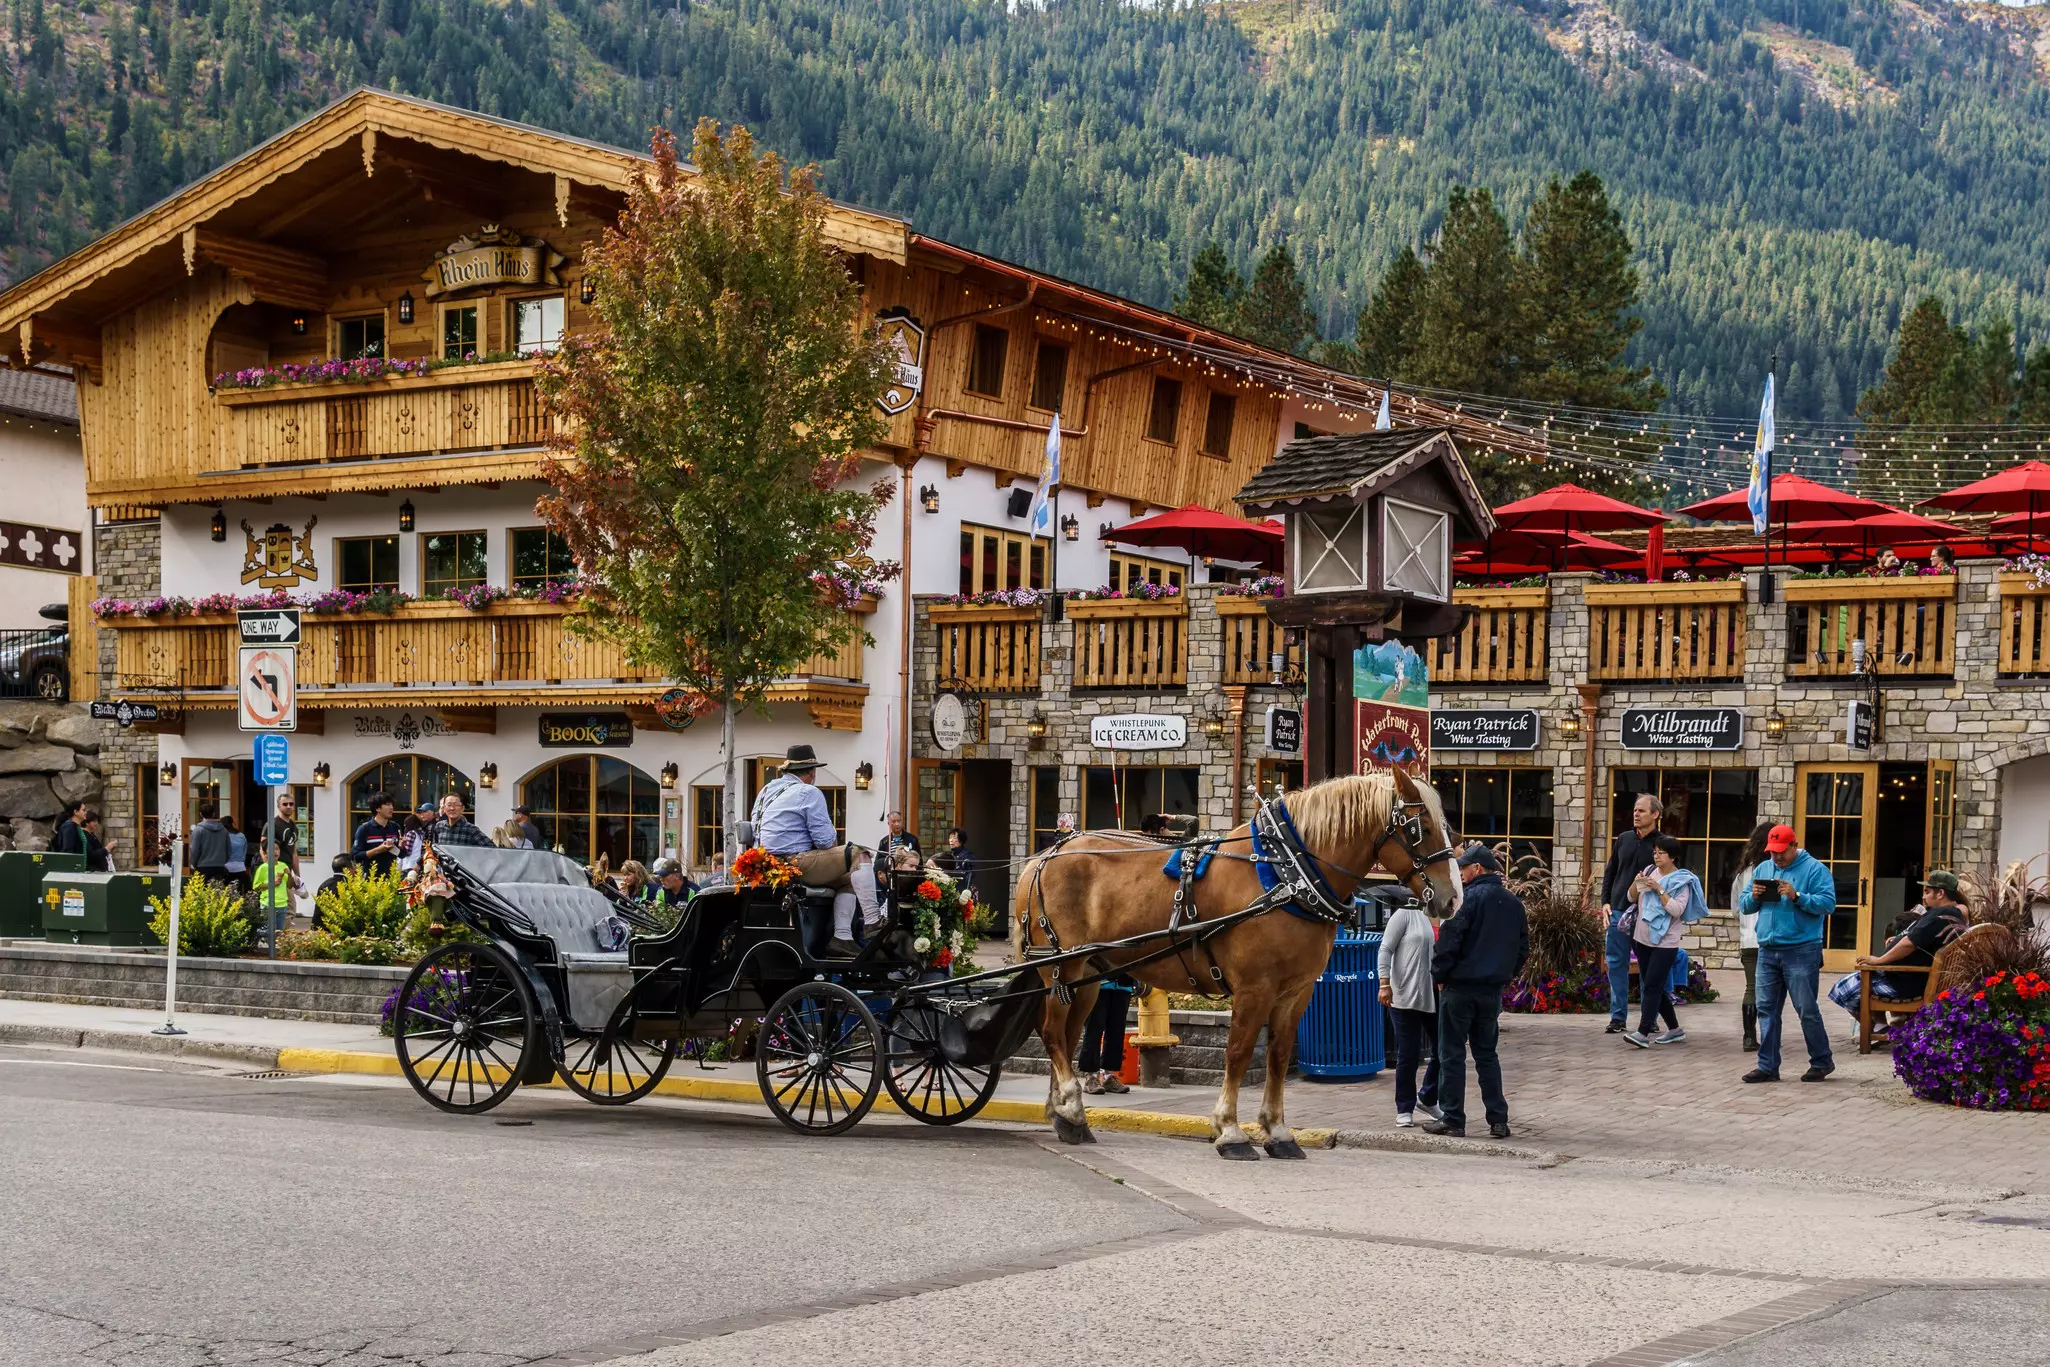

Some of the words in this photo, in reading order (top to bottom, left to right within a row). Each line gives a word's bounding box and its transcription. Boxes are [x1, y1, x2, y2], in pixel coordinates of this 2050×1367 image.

[438, 257, 490, 286] Rhein
[243, 621, 258, 634] ONE
[260, 620, 279, 634] WAY
[133, 705, 156, 718] Orchid
[354, 716, 392, 735] Black
[1110, 719, 1166, 728] WHISTLEPUNK
[1278, 716, 1294, 731] Ryan
[1433, 717, 1471, 735] Ryan
[1473, 714, 1529, 730] Patrick
[1632, 711, 1730, 733] Milbrandt
[549, 726, 605, 745] BOOK
[1095, 725, 1113, 741] ICE
[1115, 725, 1158, 741] CREAM
[1161, 725, 1181, 741] CO.
[1275, 729, 1296, 740] Patrick
[1361, 709, 1409, 751] Waterfront
[1410, 723, 1427, 762] Park
[1450, 734, 1473, 744] Wine
[1475, 732, 1511, 748] Tasting
[1648, 733, 1673, 744] Wine
[1675, 731, 1713, 748] Tasting
[1334, 973, 1358, 982] Recycle
